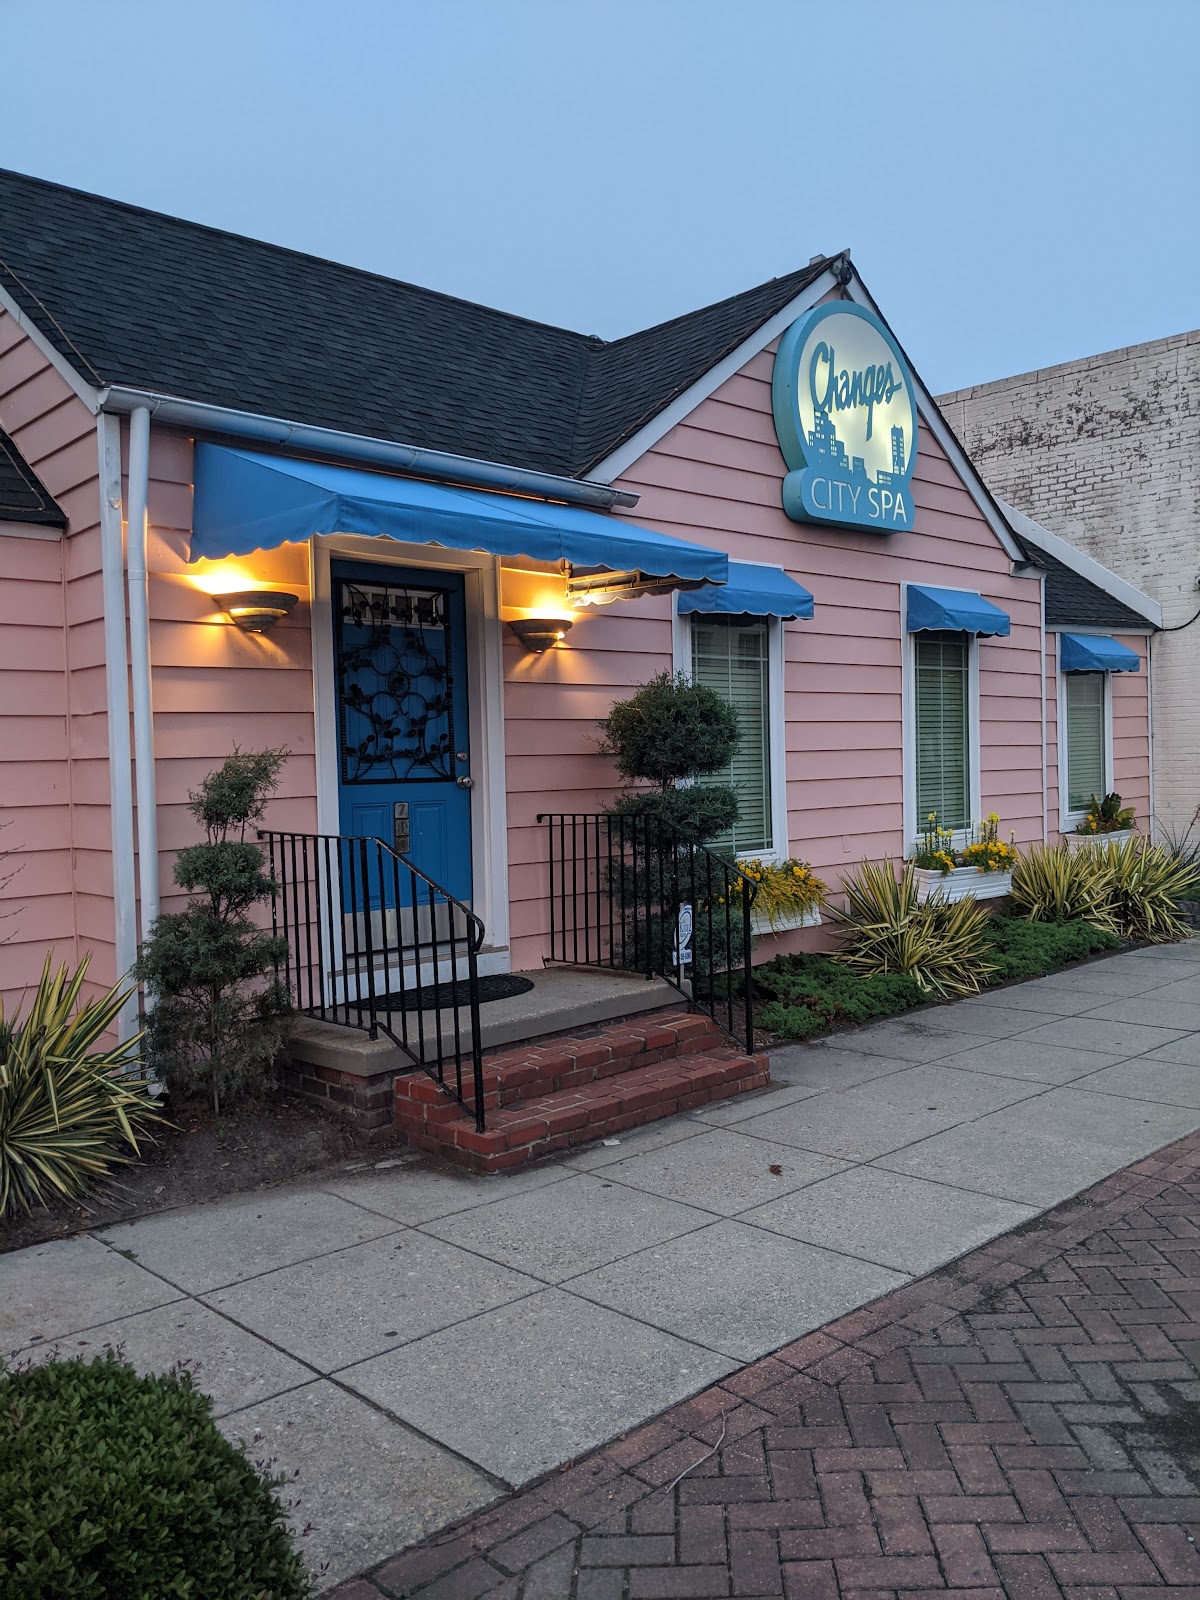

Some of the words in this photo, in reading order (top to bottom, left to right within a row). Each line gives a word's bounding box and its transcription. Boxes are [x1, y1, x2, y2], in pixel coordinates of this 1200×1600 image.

[810, 341, 902, 441] Changes
[811, 477, 861, 515] CITY
[868, 487, 907, 524] SPA
